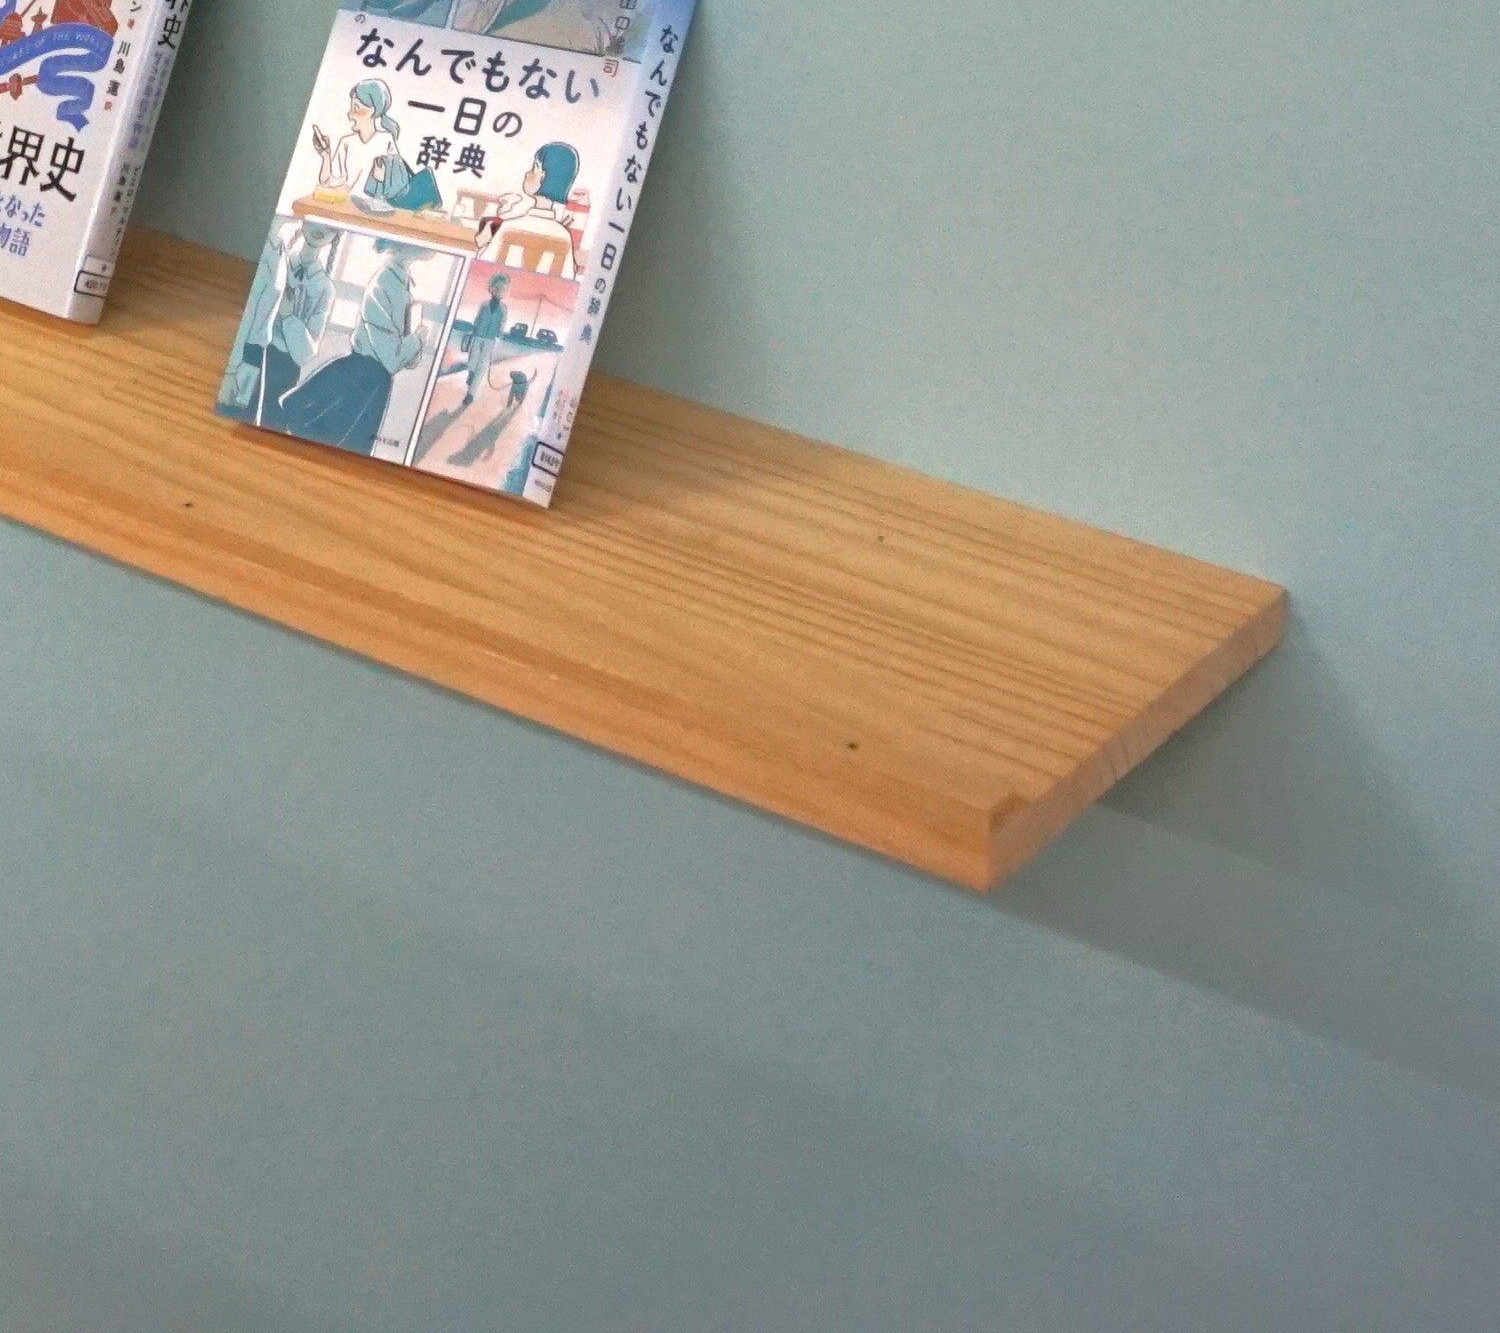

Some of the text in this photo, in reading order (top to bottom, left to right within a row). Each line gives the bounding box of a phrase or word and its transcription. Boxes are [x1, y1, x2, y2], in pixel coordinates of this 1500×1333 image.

[355, 28, 600, 104] なんでもない
[407, 96, 524, 138] 一日の
[415, 135, 487, 180] 辞典
